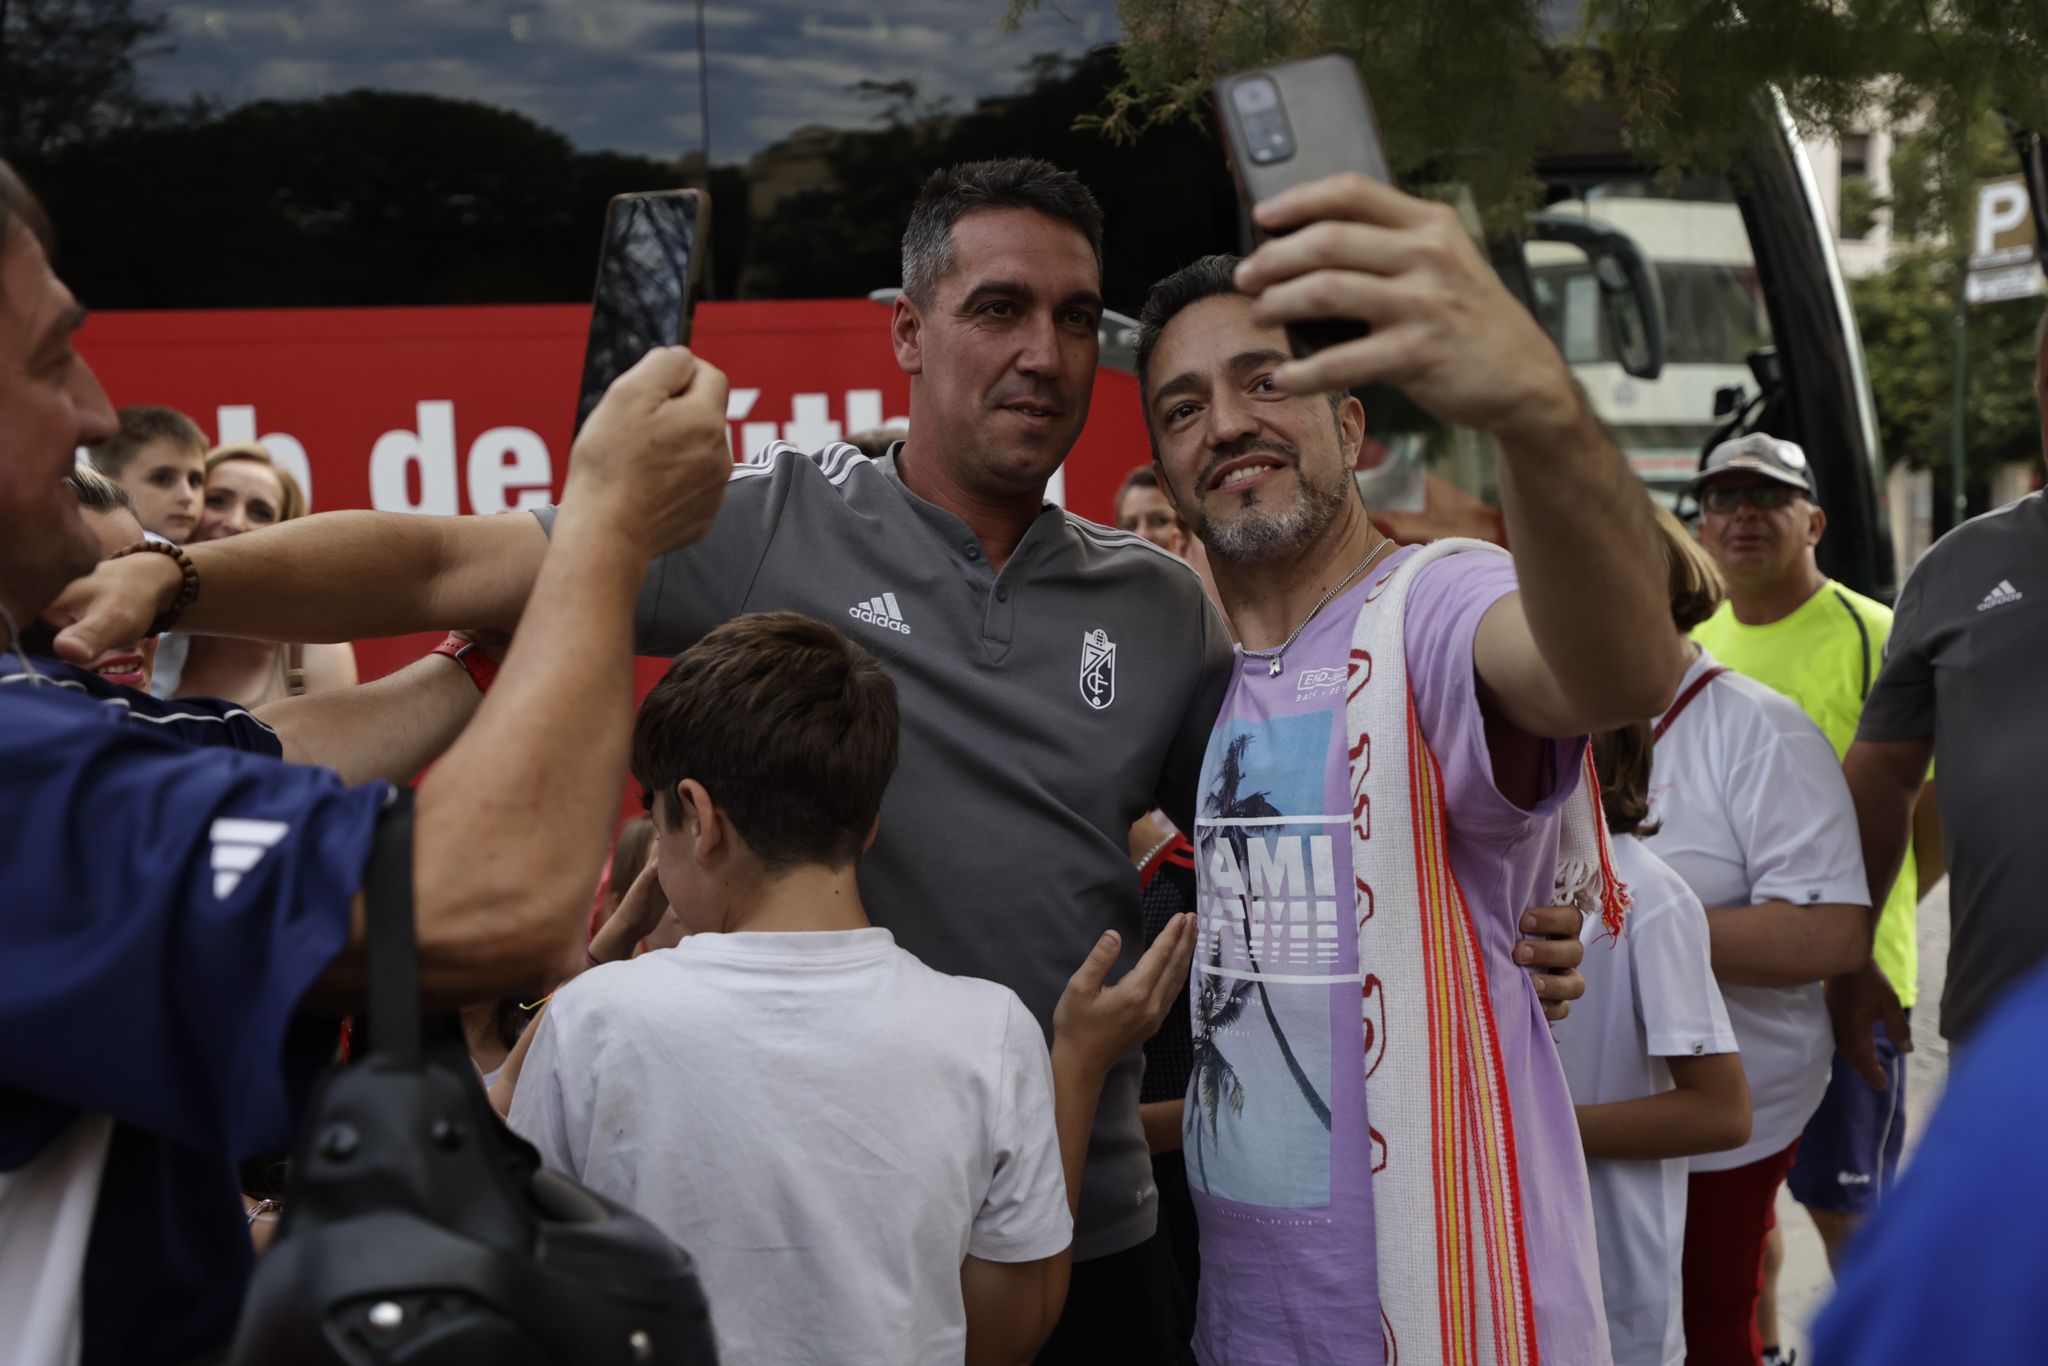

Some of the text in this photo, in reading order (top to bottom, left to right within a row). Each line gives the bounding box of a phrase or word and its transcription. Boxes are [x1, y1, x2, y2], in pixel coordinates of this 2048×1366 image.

[1978, 184, 2029, 255] P
[368, 399, 553, 516] de
[849, 607, 911, 634] adidas
